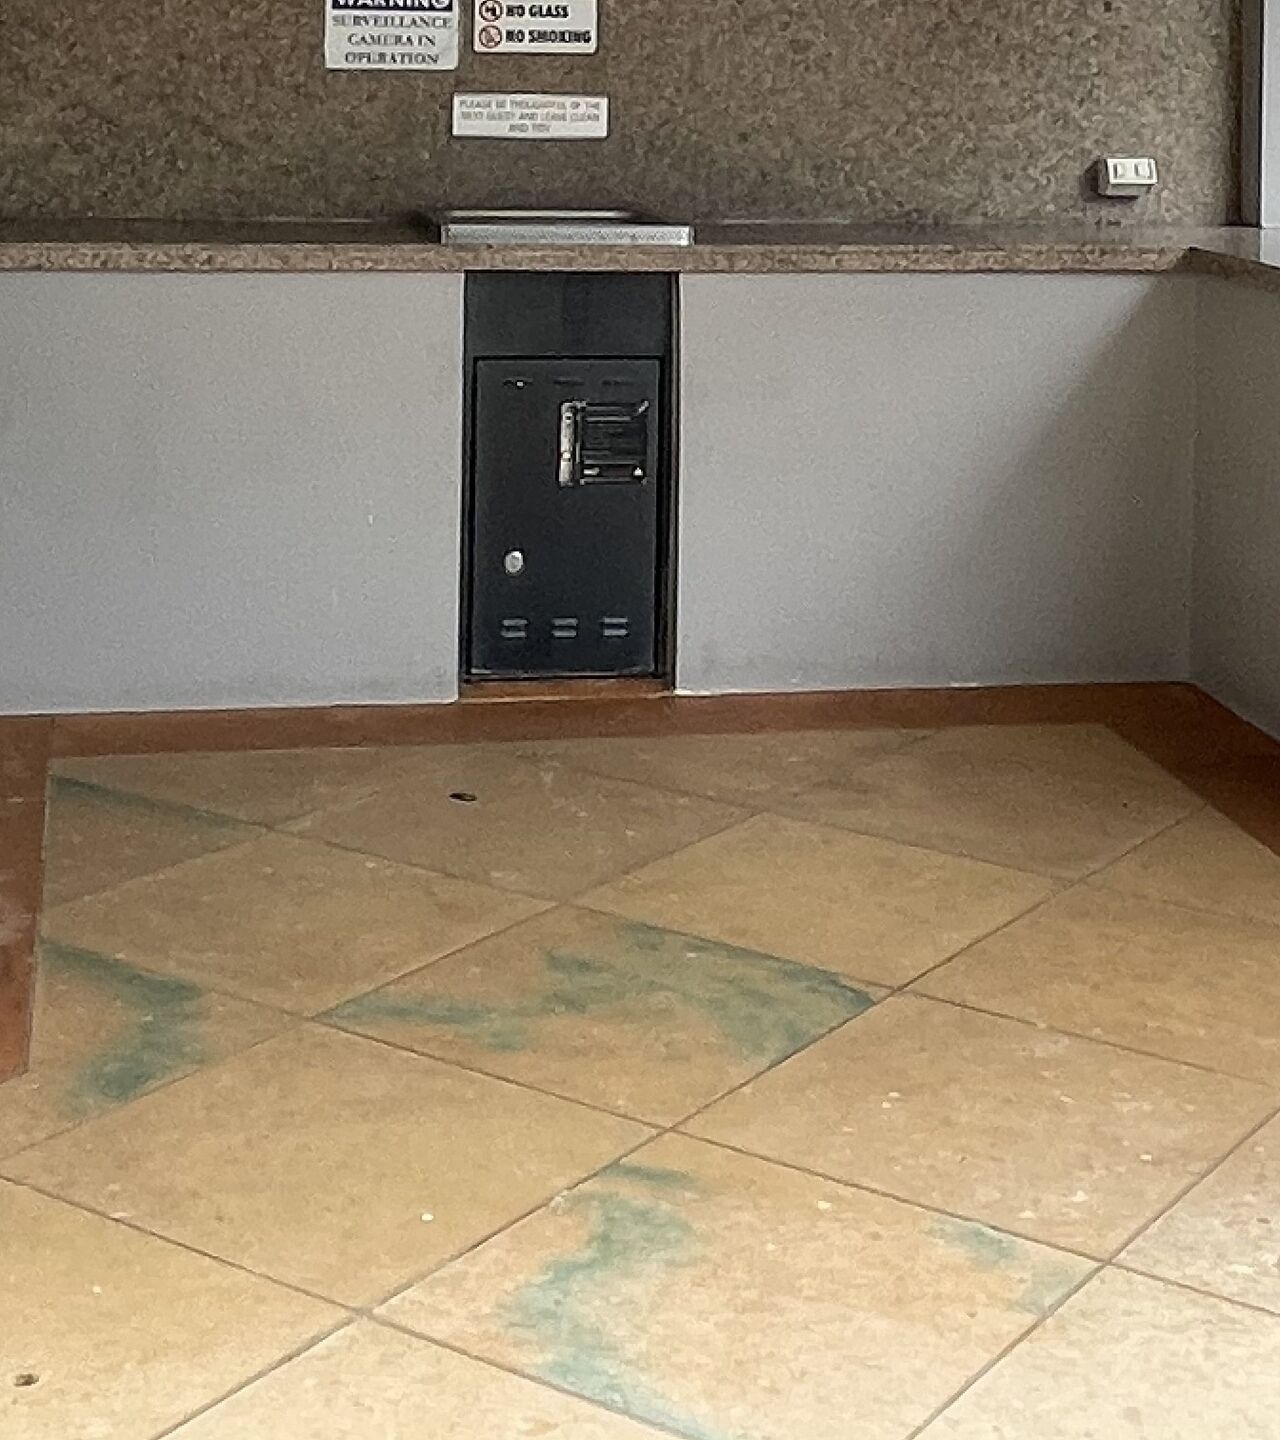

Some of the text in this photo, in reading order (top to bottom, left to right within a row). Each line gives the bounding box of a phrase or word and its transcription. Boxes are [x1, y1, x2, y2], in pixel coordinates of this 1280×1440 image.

[505, 4, 569, 18] NO GLASS
[332, 15, 453, 28] SURVEILLANCE
[347, 32, 436, 46] CAMERA IN
[505, 29, 592, 43] NO SMOKING
[345, 51, 439, 65] OPERATION
[459, 99, 492, 109] PLEASE
